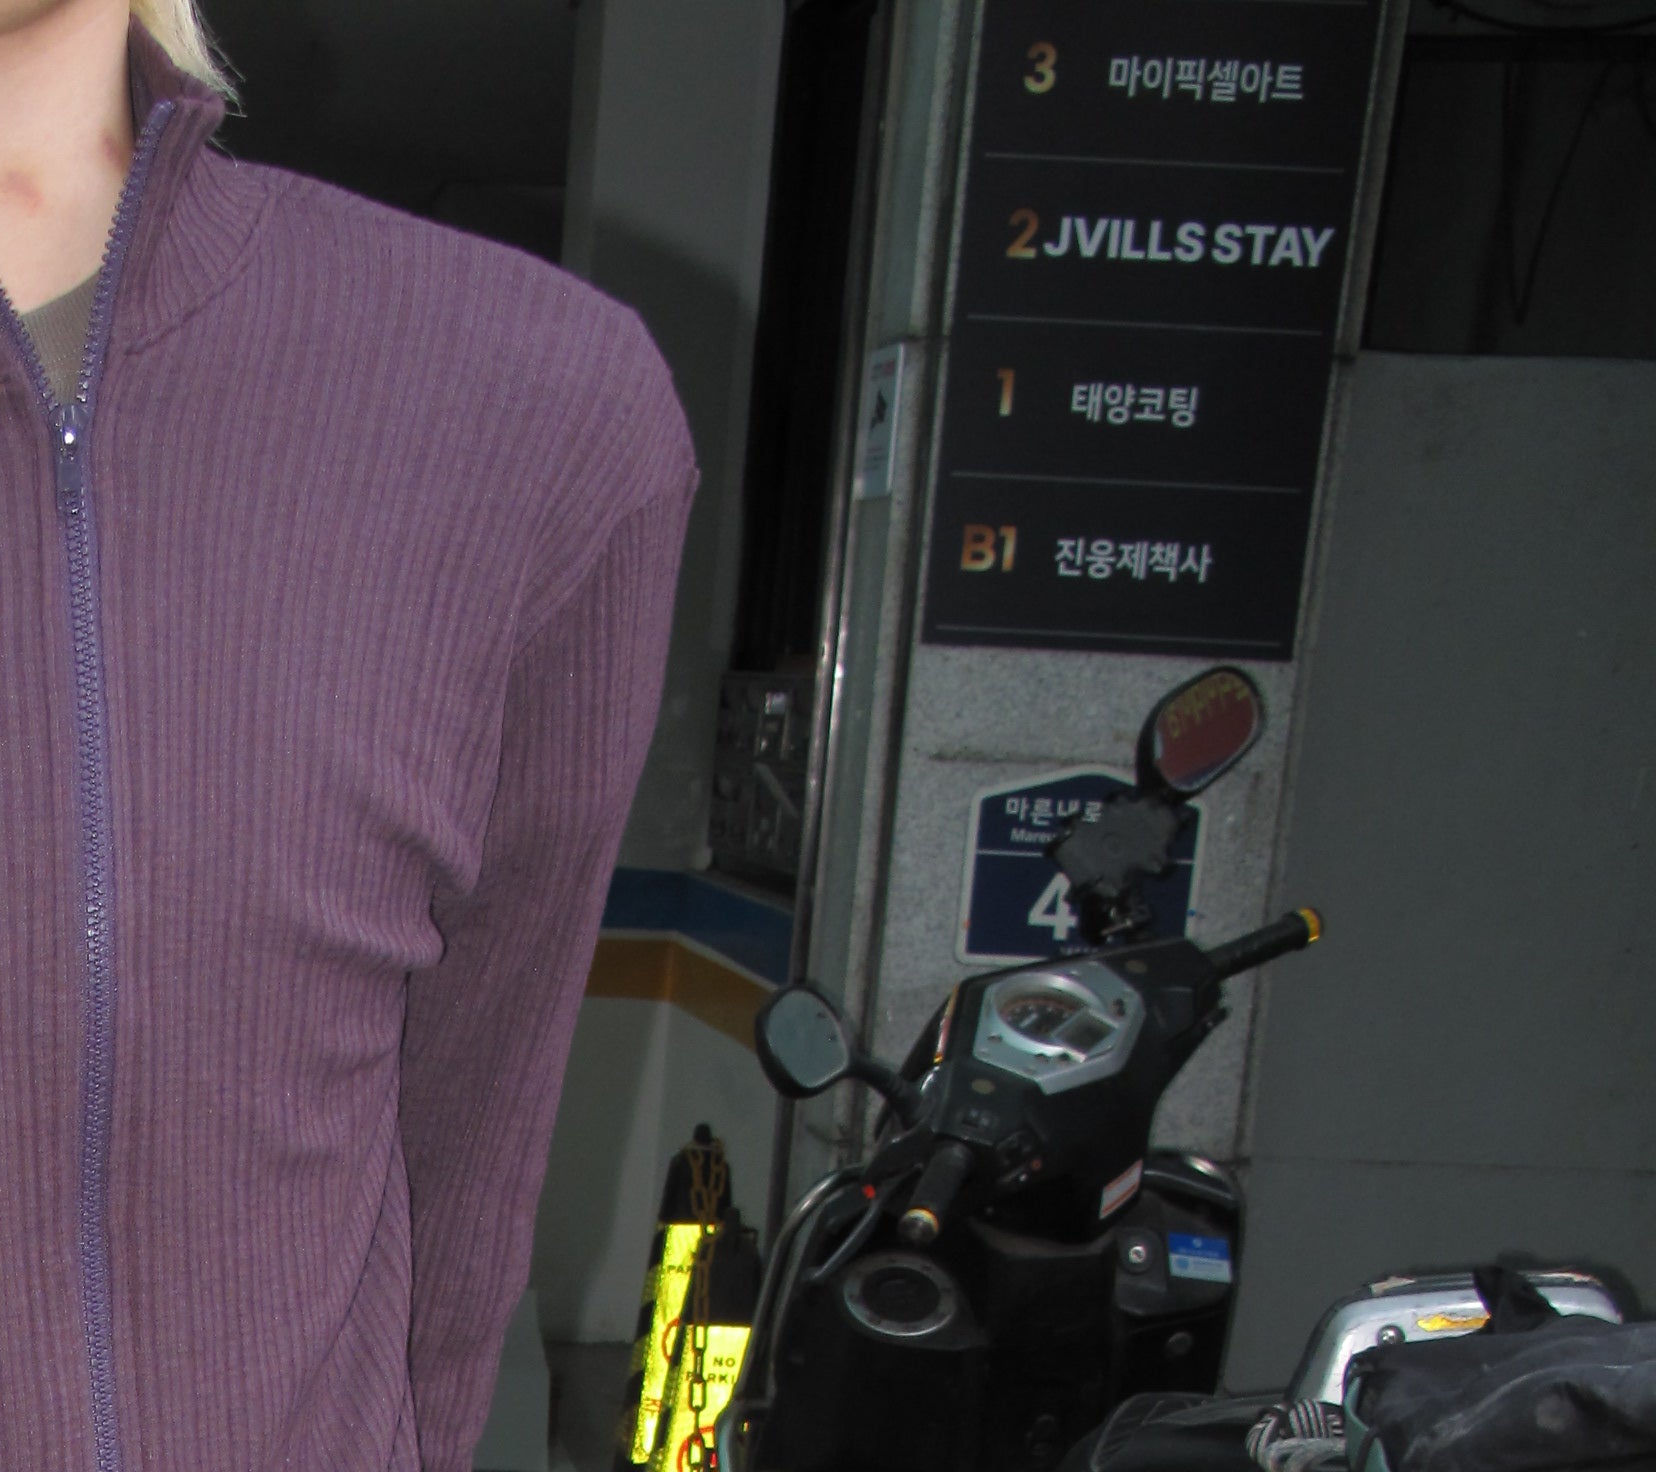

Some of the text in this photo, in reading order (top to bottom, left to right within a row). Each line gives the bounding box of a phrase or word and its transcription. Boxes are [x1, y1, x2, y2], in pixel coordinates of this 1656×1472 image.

[1024, 43, 1303, 103] 3 마이픽셀아트
[1006, 209, 1334, 267] 2 JVILLS STAY
[997, 369, 1199, 428] 1 태양코팅
[960, 524, 1212, 584] B1 진웅제책사
